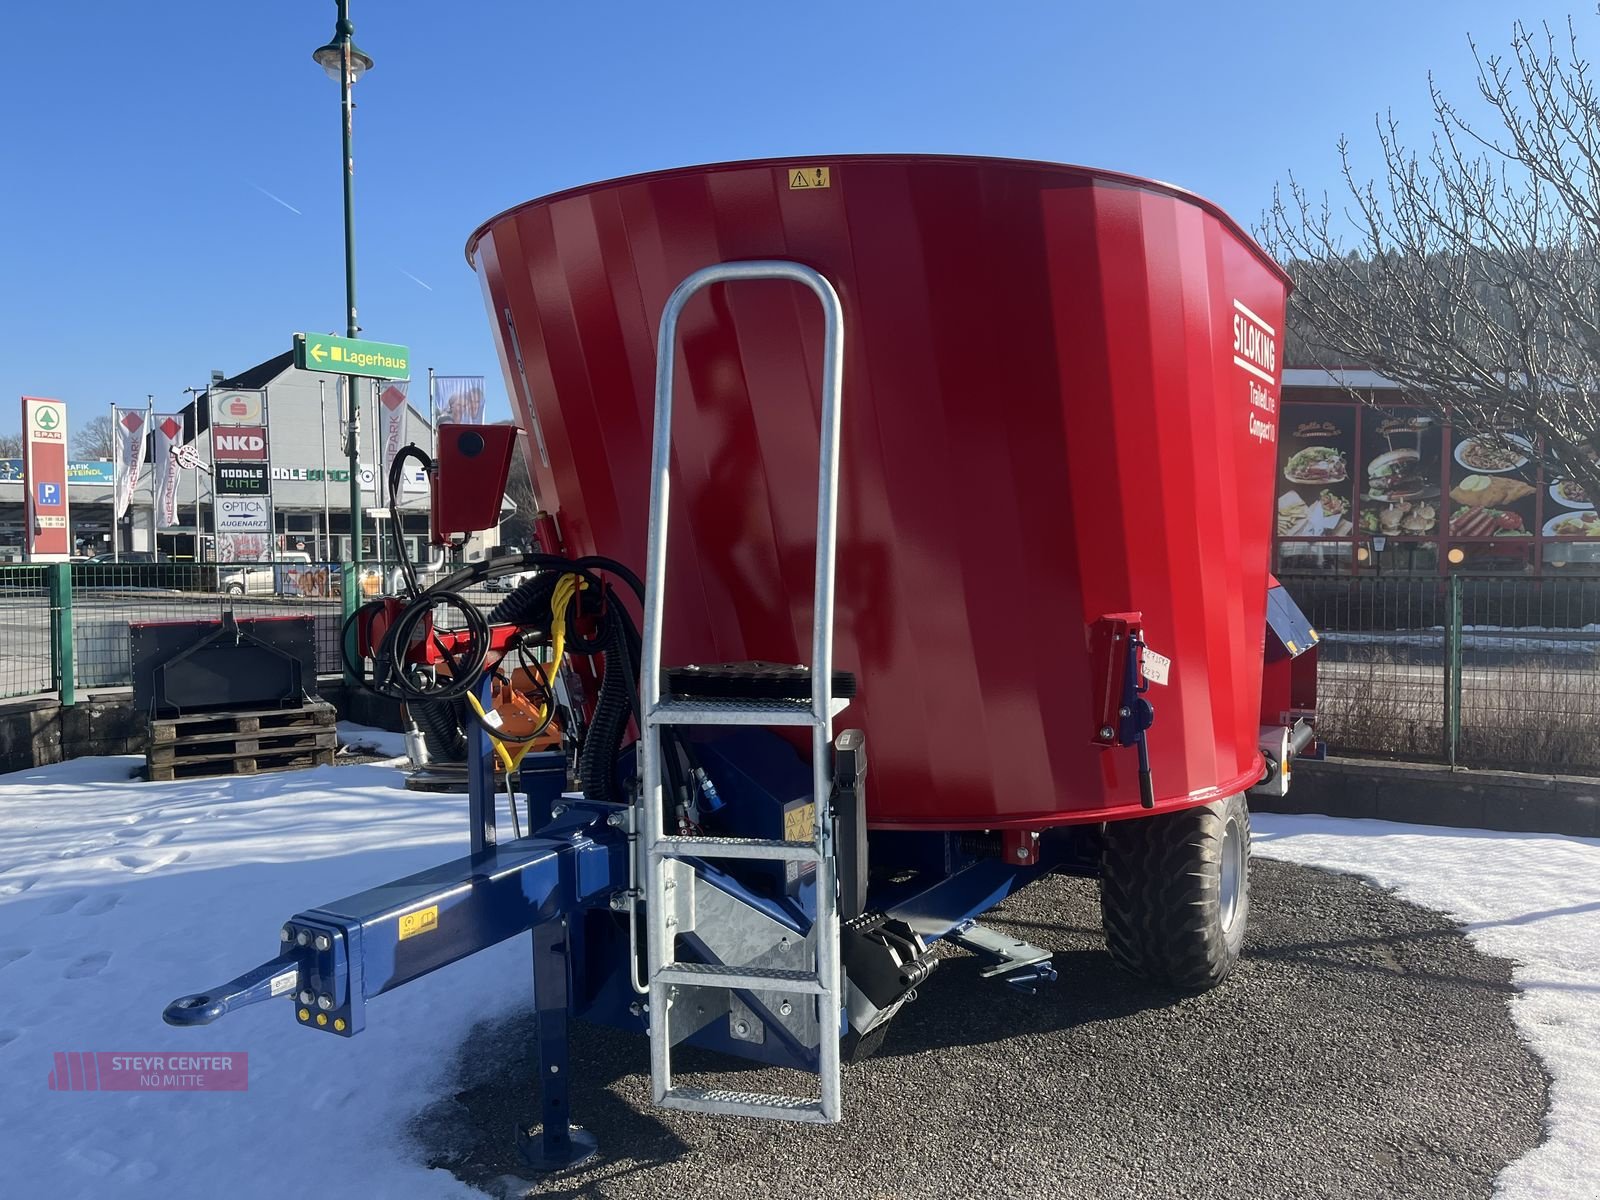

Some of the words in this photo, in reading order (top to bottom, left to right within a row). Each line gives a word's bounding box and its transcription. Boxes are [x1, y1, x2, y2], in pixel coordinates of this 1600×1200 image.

[1233, 313, 1275, 373] SILOKING
[343, 347, 407, 370] Lagerhaus
[34, 431, 62, 439] SPAR
[216, 435, 264, 451] NKD
[221, 469, 263, 479] NOODLE
[272, 468, 307, 480] ODLE
[225, 480, 260, 489] KING
[44, 484, 56, 498] P
[222, 501, 264, 512] OPTICA
